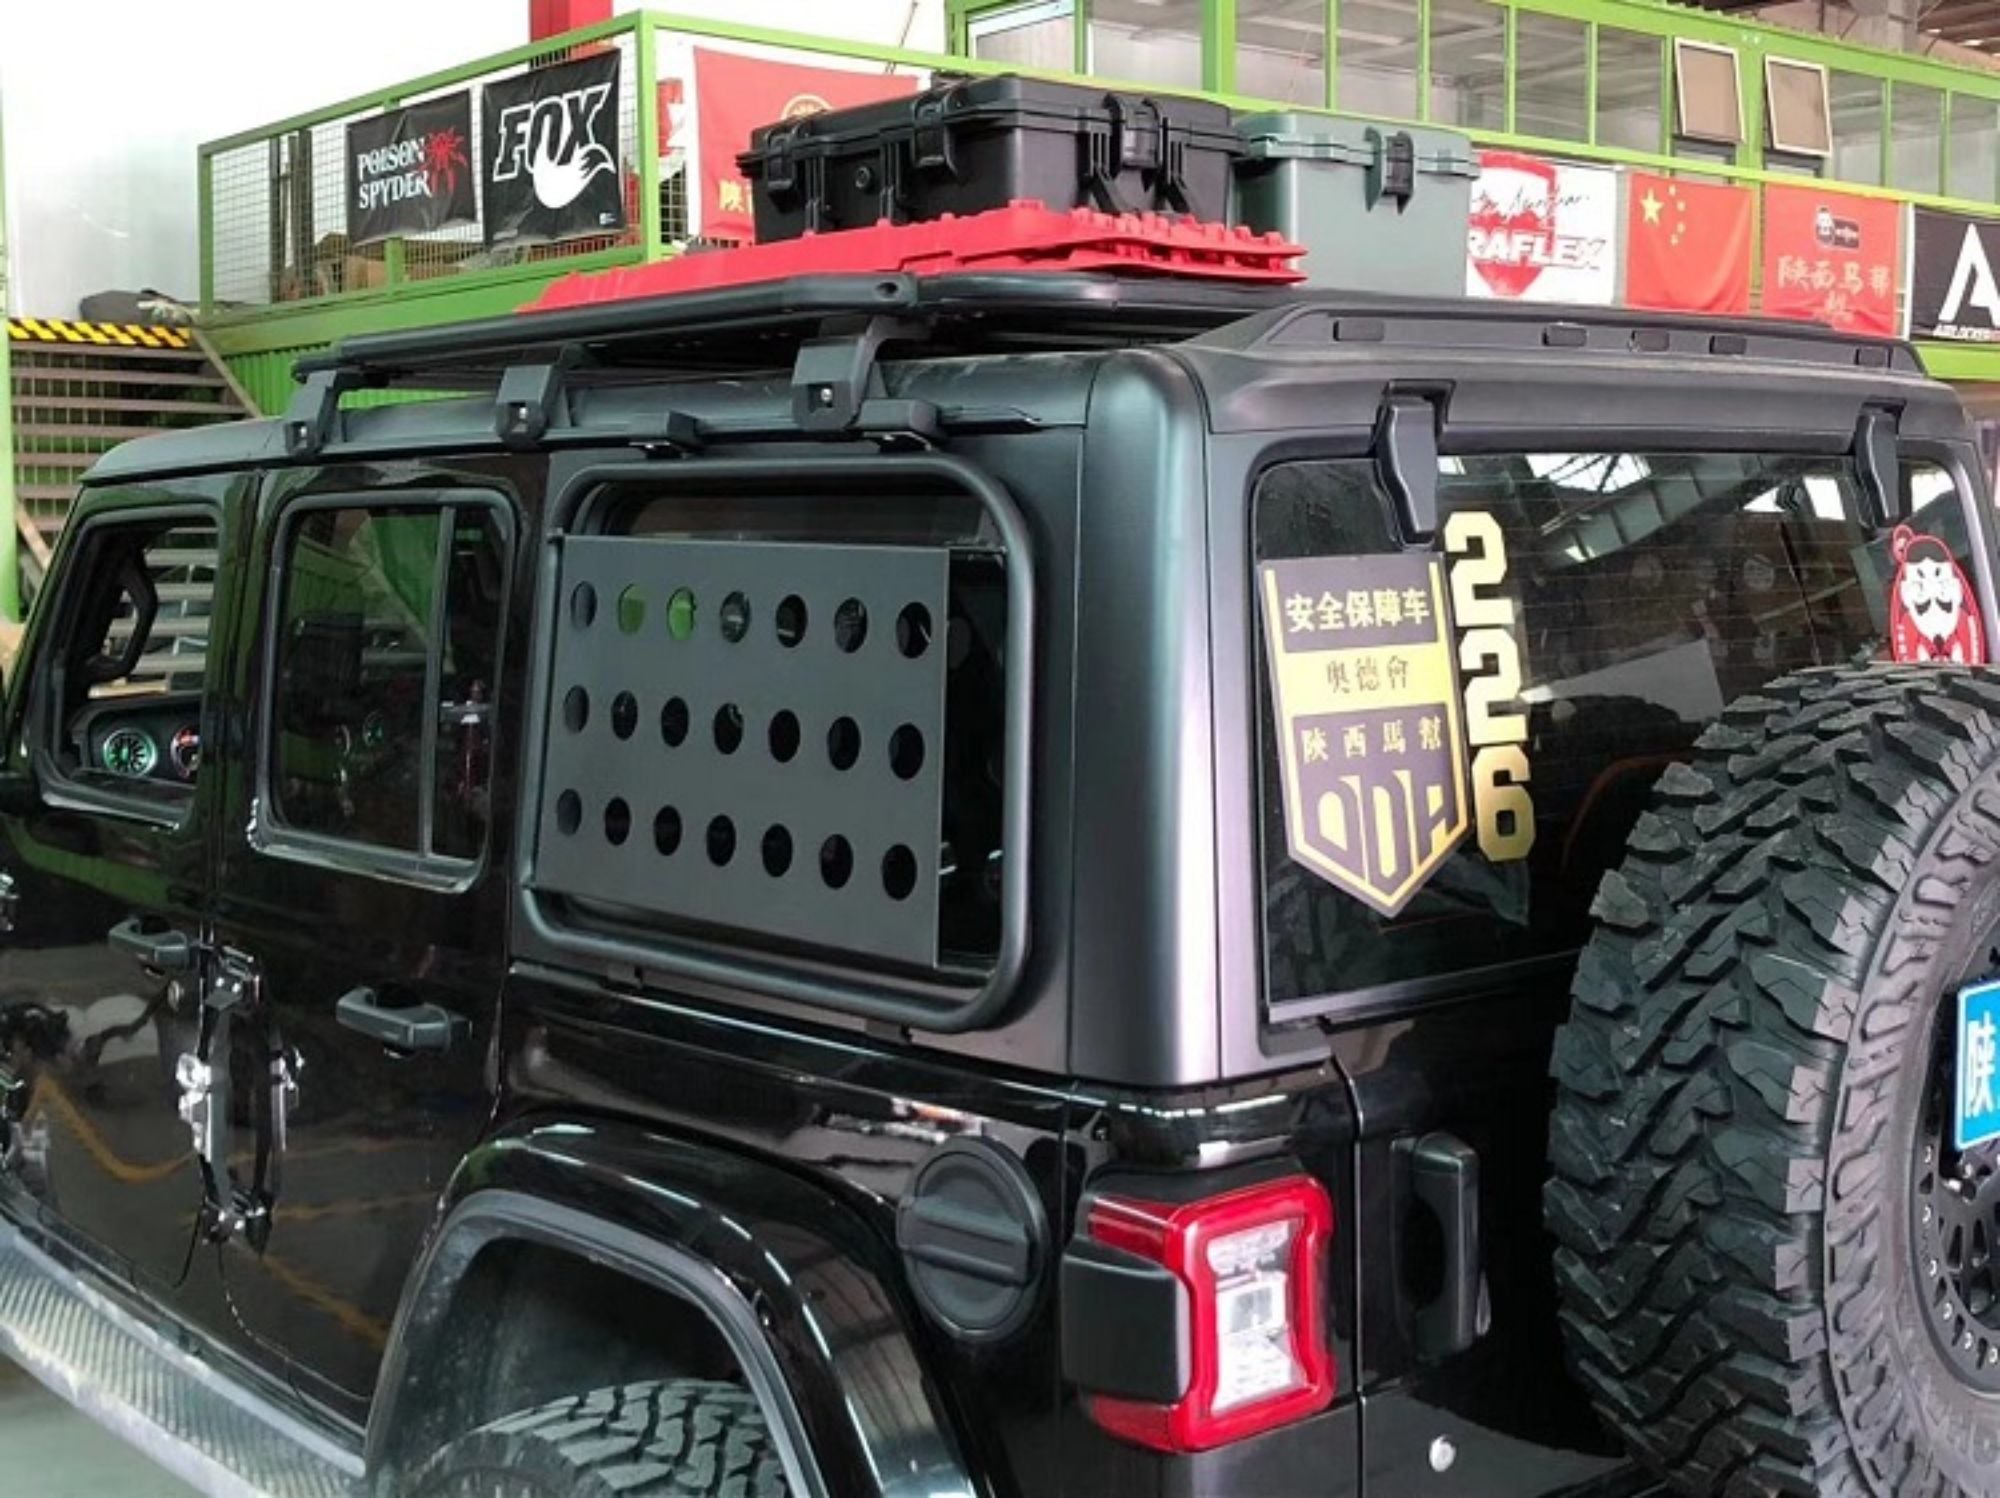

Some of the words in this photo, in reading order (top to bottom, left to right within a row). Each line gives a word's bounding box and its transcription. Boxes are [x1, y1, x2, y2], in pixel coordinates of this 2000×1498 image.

[493, 82, 612, 182] FOX
[357, 137, 425, 182] POISON
[359, 170, 432, 209] SPYDER
[1285, 587, 1430, 633] 安全保障车
